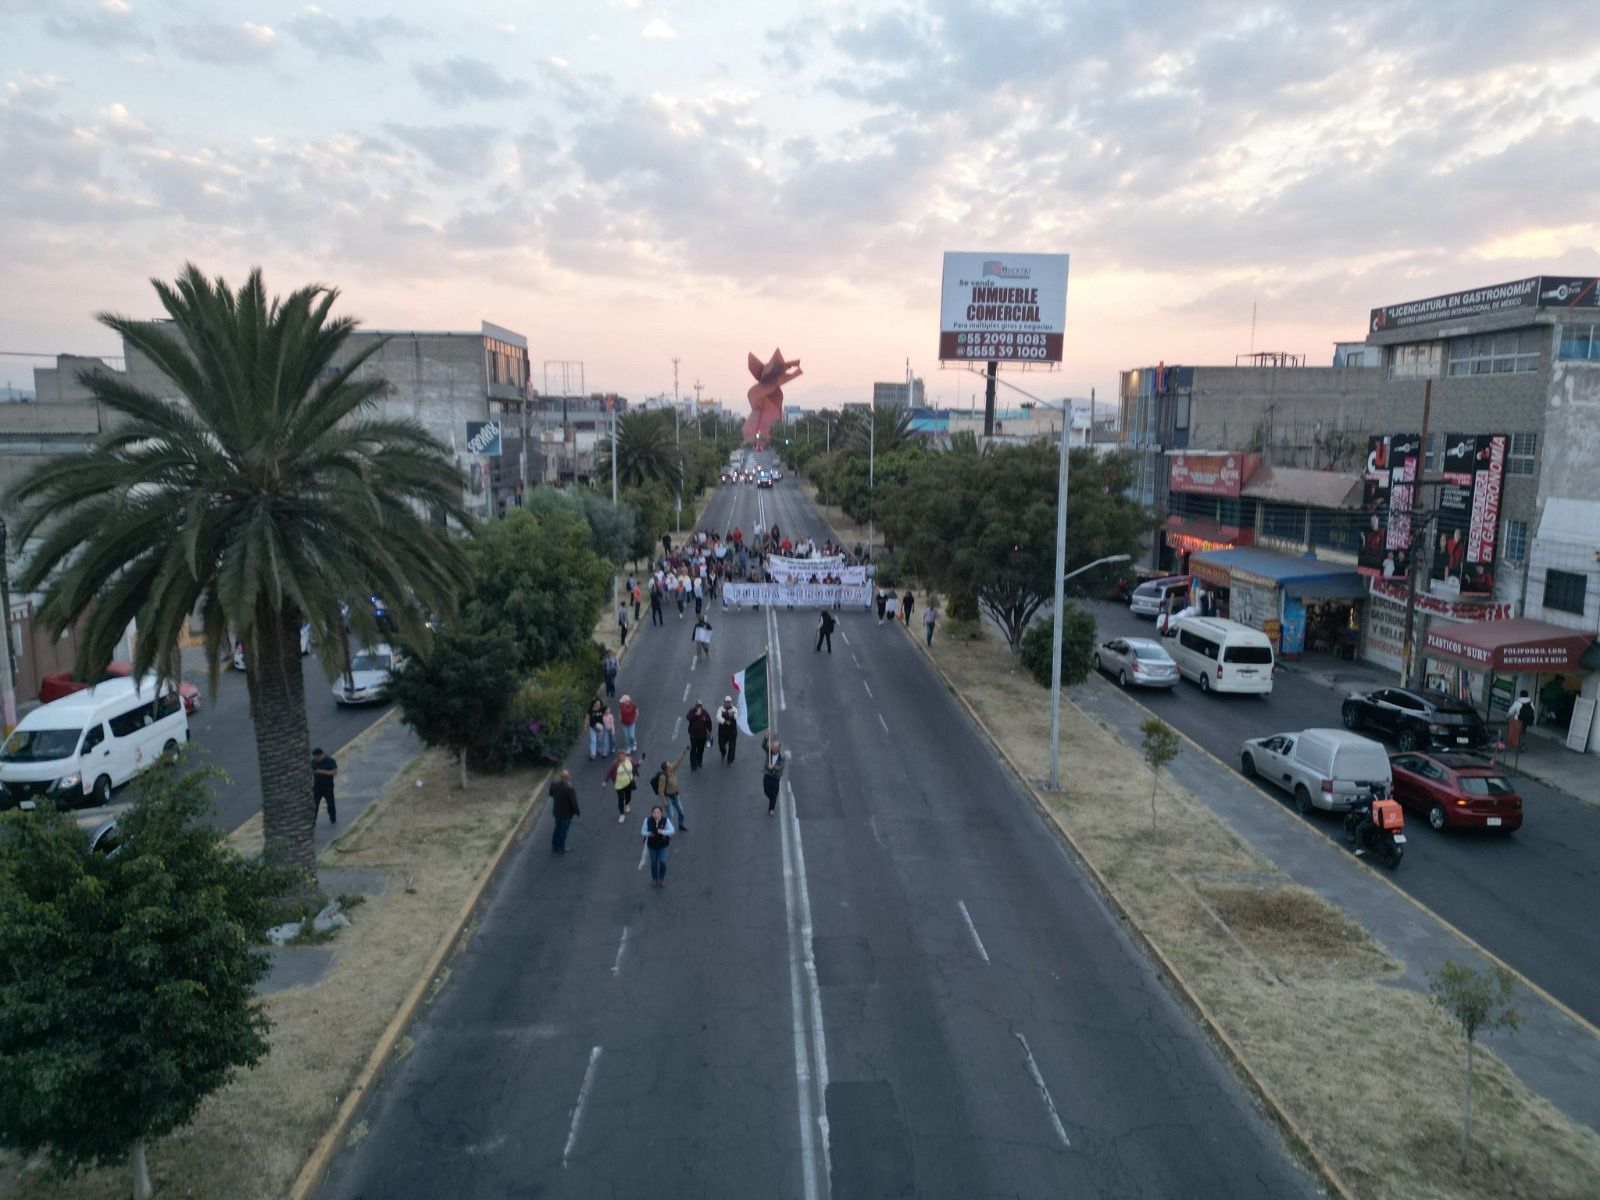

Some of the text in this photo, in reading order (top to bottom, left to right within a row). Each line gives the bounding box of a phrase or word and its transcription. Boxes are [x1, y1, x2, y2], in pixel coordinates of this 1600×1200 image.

[970, 279, 995, 287] vende
[972, 287, 1038, 304] INMUEBLE
[1448, 296, 1461, 307] EN
[966, 304, 1041, 322] COMERCIAL
[1023, 322, 1053, 331] negocios
[967, 333, 1047, 345] 55 2098 8083
[966, 345, 1047, 358] 5555 39 1000
[1482, 436, 1506, 561] EN GASTRONOMÍA
[1467, 470, 1489, 562] LICENCIATURA
[1427, 633, 1462, 654] PLÁSTICOS
[1547, 646, 1567, 655] LONA
[1503, 655, 1543, 664] RETACERÍA
[1550, 656, 1568, 664] KILO
